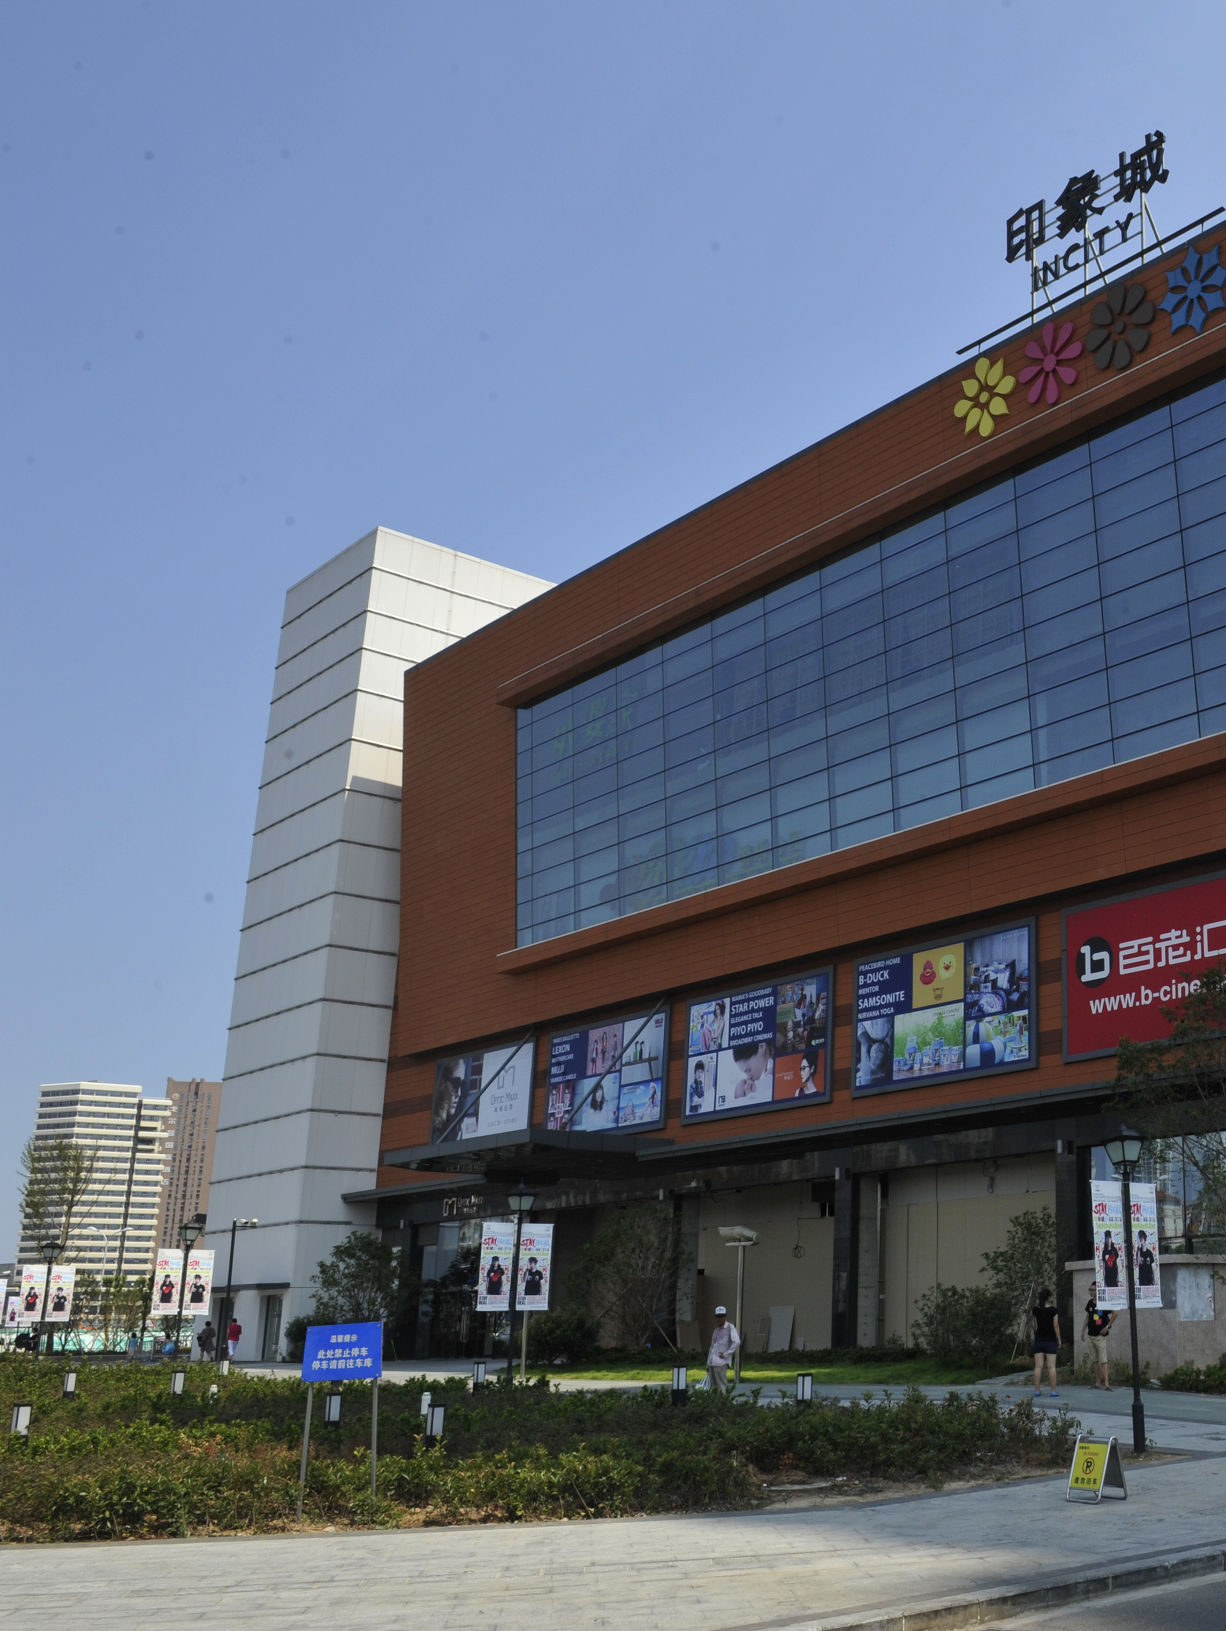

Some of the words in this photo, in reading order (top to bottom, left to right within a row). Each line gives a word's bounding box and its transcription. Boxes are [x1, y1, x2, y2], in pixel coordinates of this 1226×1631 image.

[1005, 129, 1170, 263] 印象城
[1033, 212, 1134, 292] INCITY
[859, 969, 890, 986] B-DUCK
[731, 1002, 748, 1015] STAR
[749, 996, 774, 1010] POWER
[858, 991, 905, 1009] SAMSONITE
[730, 1025, 746, 1037] PIYO
[747, 1021, 764, 1033] PIYO
[317, 1347, 369, 1359] 此处禁止停车
[312, 1358, 373, 1370] 停车请前往车库
